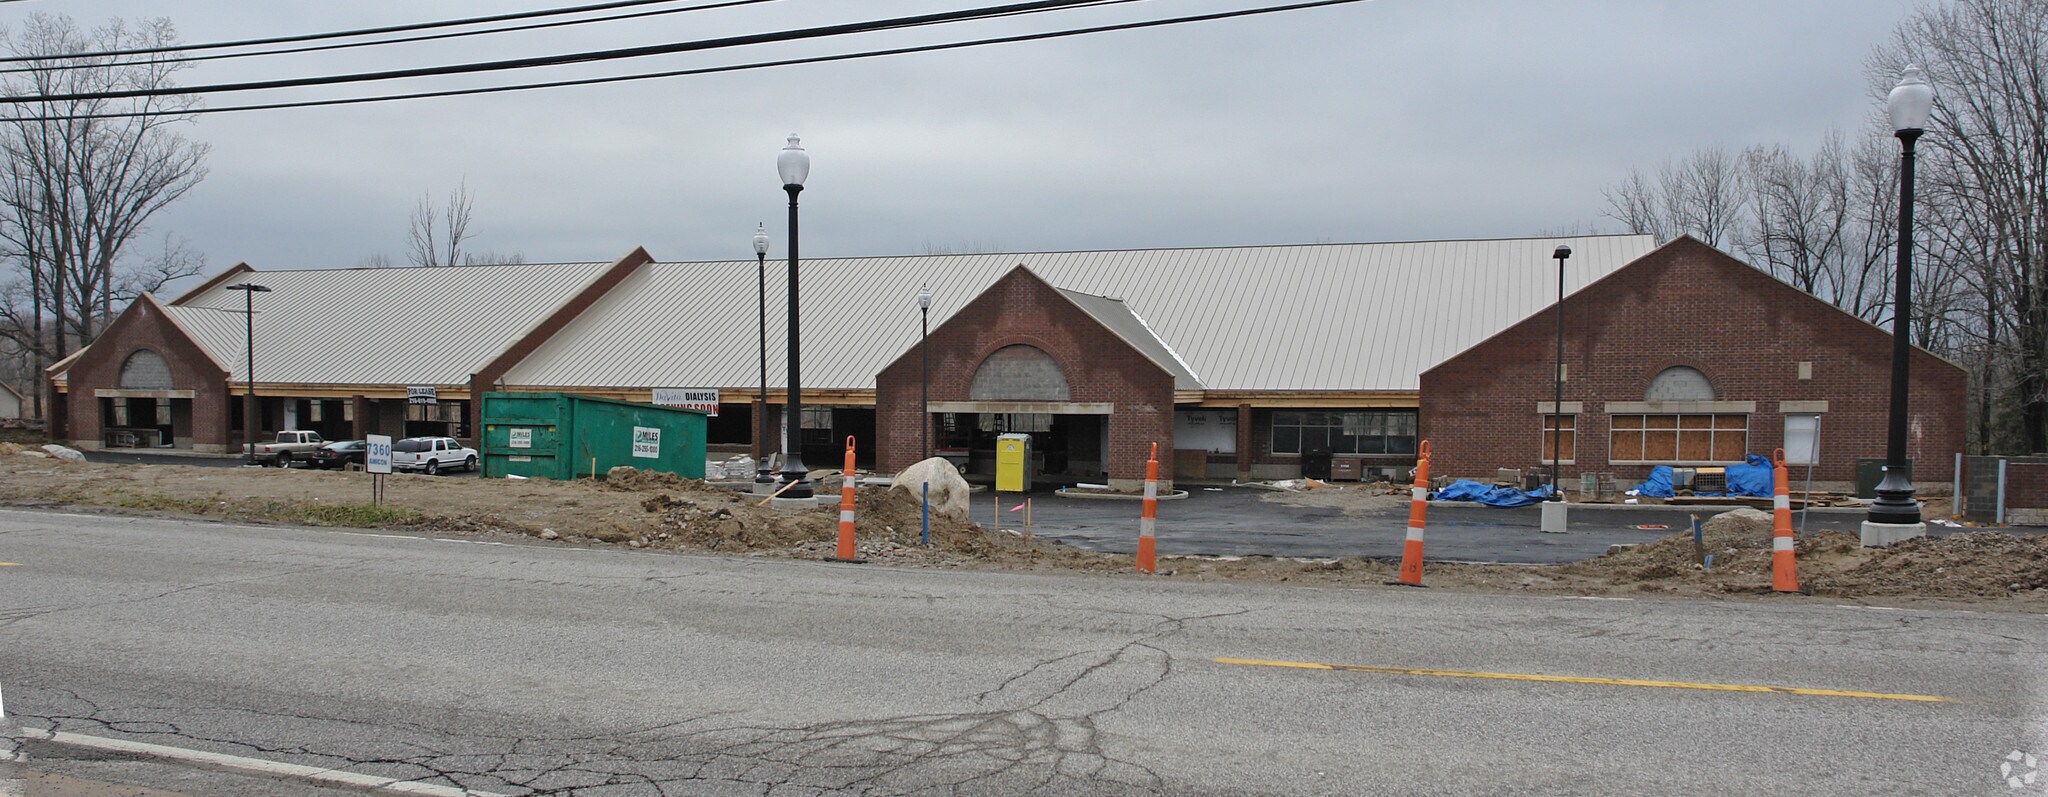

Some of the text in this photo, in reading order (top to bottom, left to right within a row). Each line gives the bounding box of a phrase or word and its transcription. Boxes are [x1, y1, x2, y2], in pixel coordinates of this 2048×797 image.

[685, 392, 716, 401] DIALYSIS
[642, 431, 658, 441] MILES
[367, 443, 390, 456] 7360
